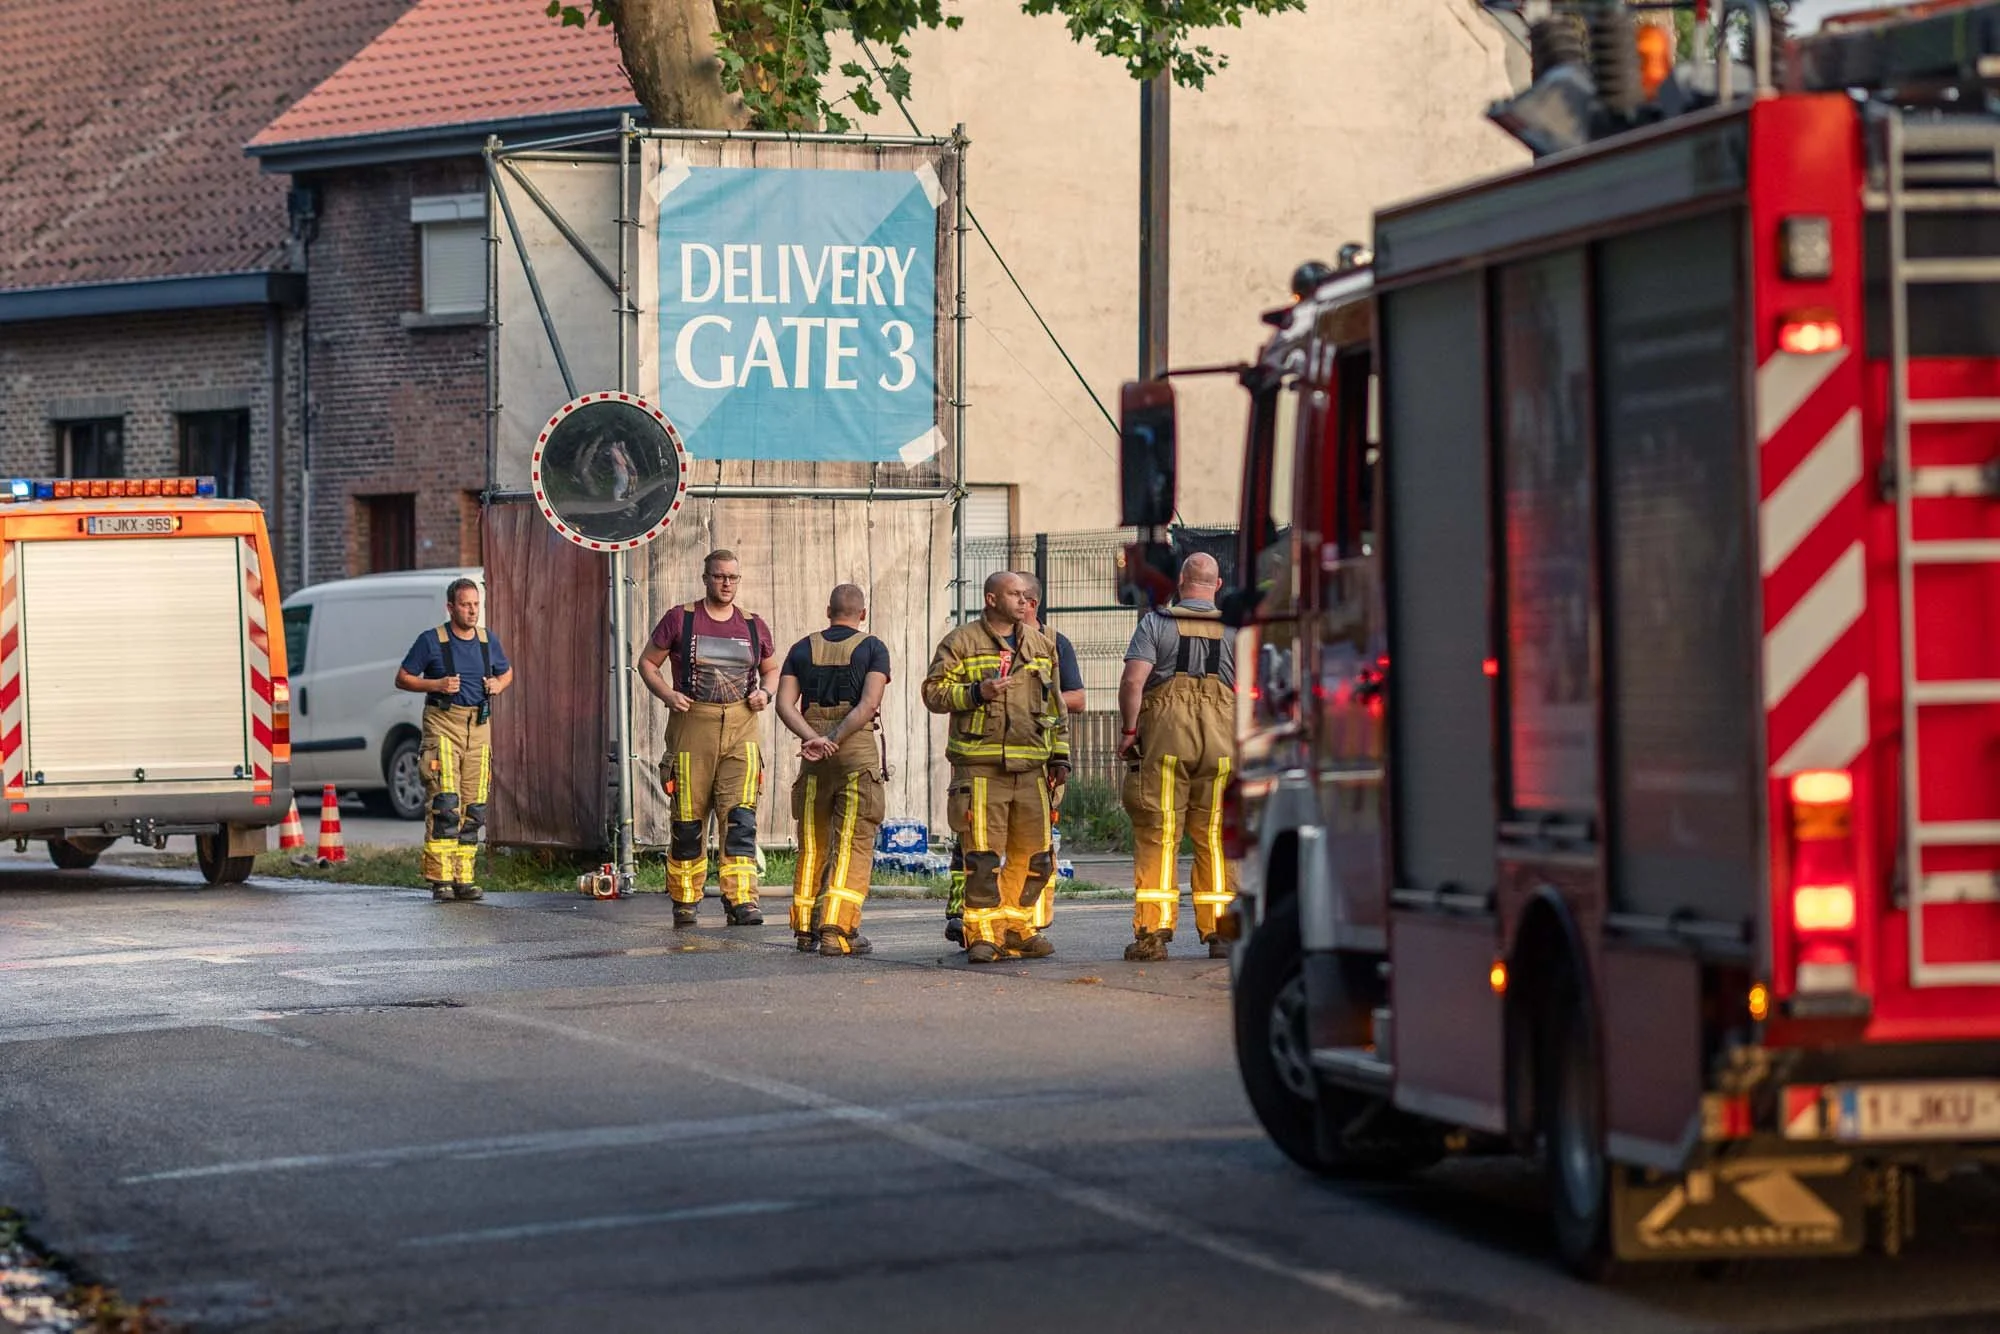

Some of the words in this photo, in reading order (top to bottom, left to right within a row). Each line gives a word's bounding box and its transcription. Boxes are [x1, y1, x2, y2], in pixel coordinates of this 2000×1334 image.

[680, 242, 917, 306] DELIVERY
[675, 315, 859, 389] GATE
[878, 319, 917, 392] 3
